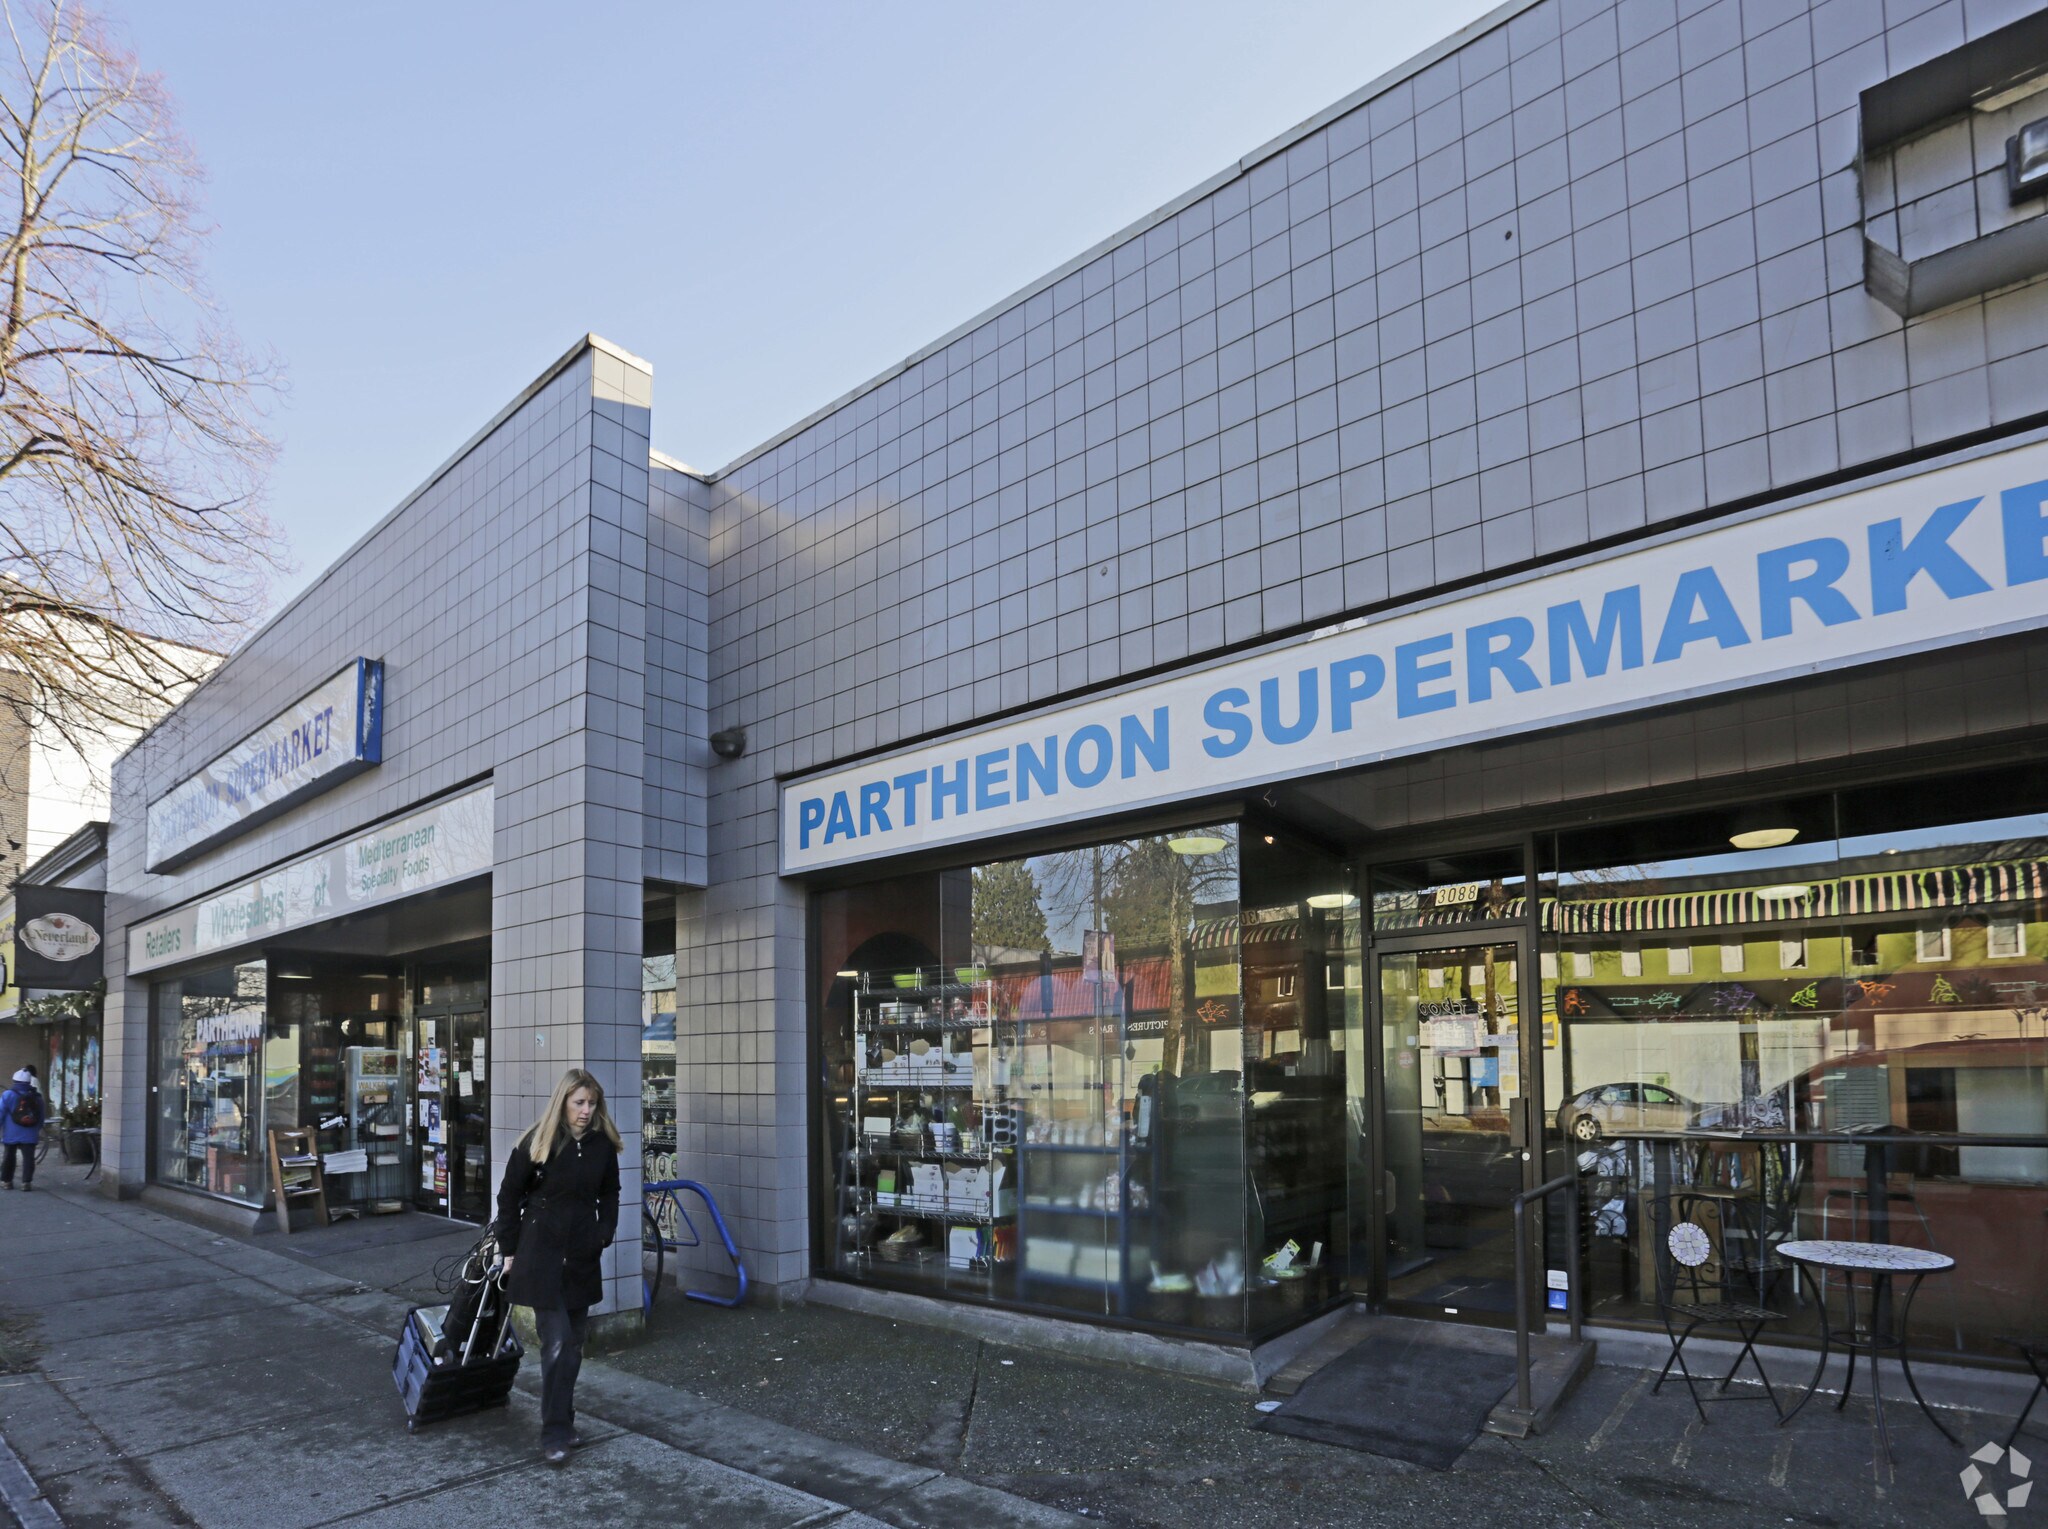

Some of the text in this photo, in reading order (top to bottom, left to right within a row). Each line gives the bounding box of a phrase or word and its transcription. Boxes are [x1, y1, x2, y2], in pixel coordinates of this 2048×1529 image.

[226, 706, 333, 807] SUPERMARKET
[800, 706, 1169, 850] PARTHENON
[358, 823, 435, 868] Mediterranean
[361, 854, 430, 894] Specialty Foods
[1438, 884, 1477, 904] 3088
[31, 929, 89, 944] Neverland
[146, 925, 181, 960] Retailers
[211, 888, 285, 940] Wholesalers
[314, 877, 327, 908] of
[196, 1014, 261, 1042] PARTHENON
